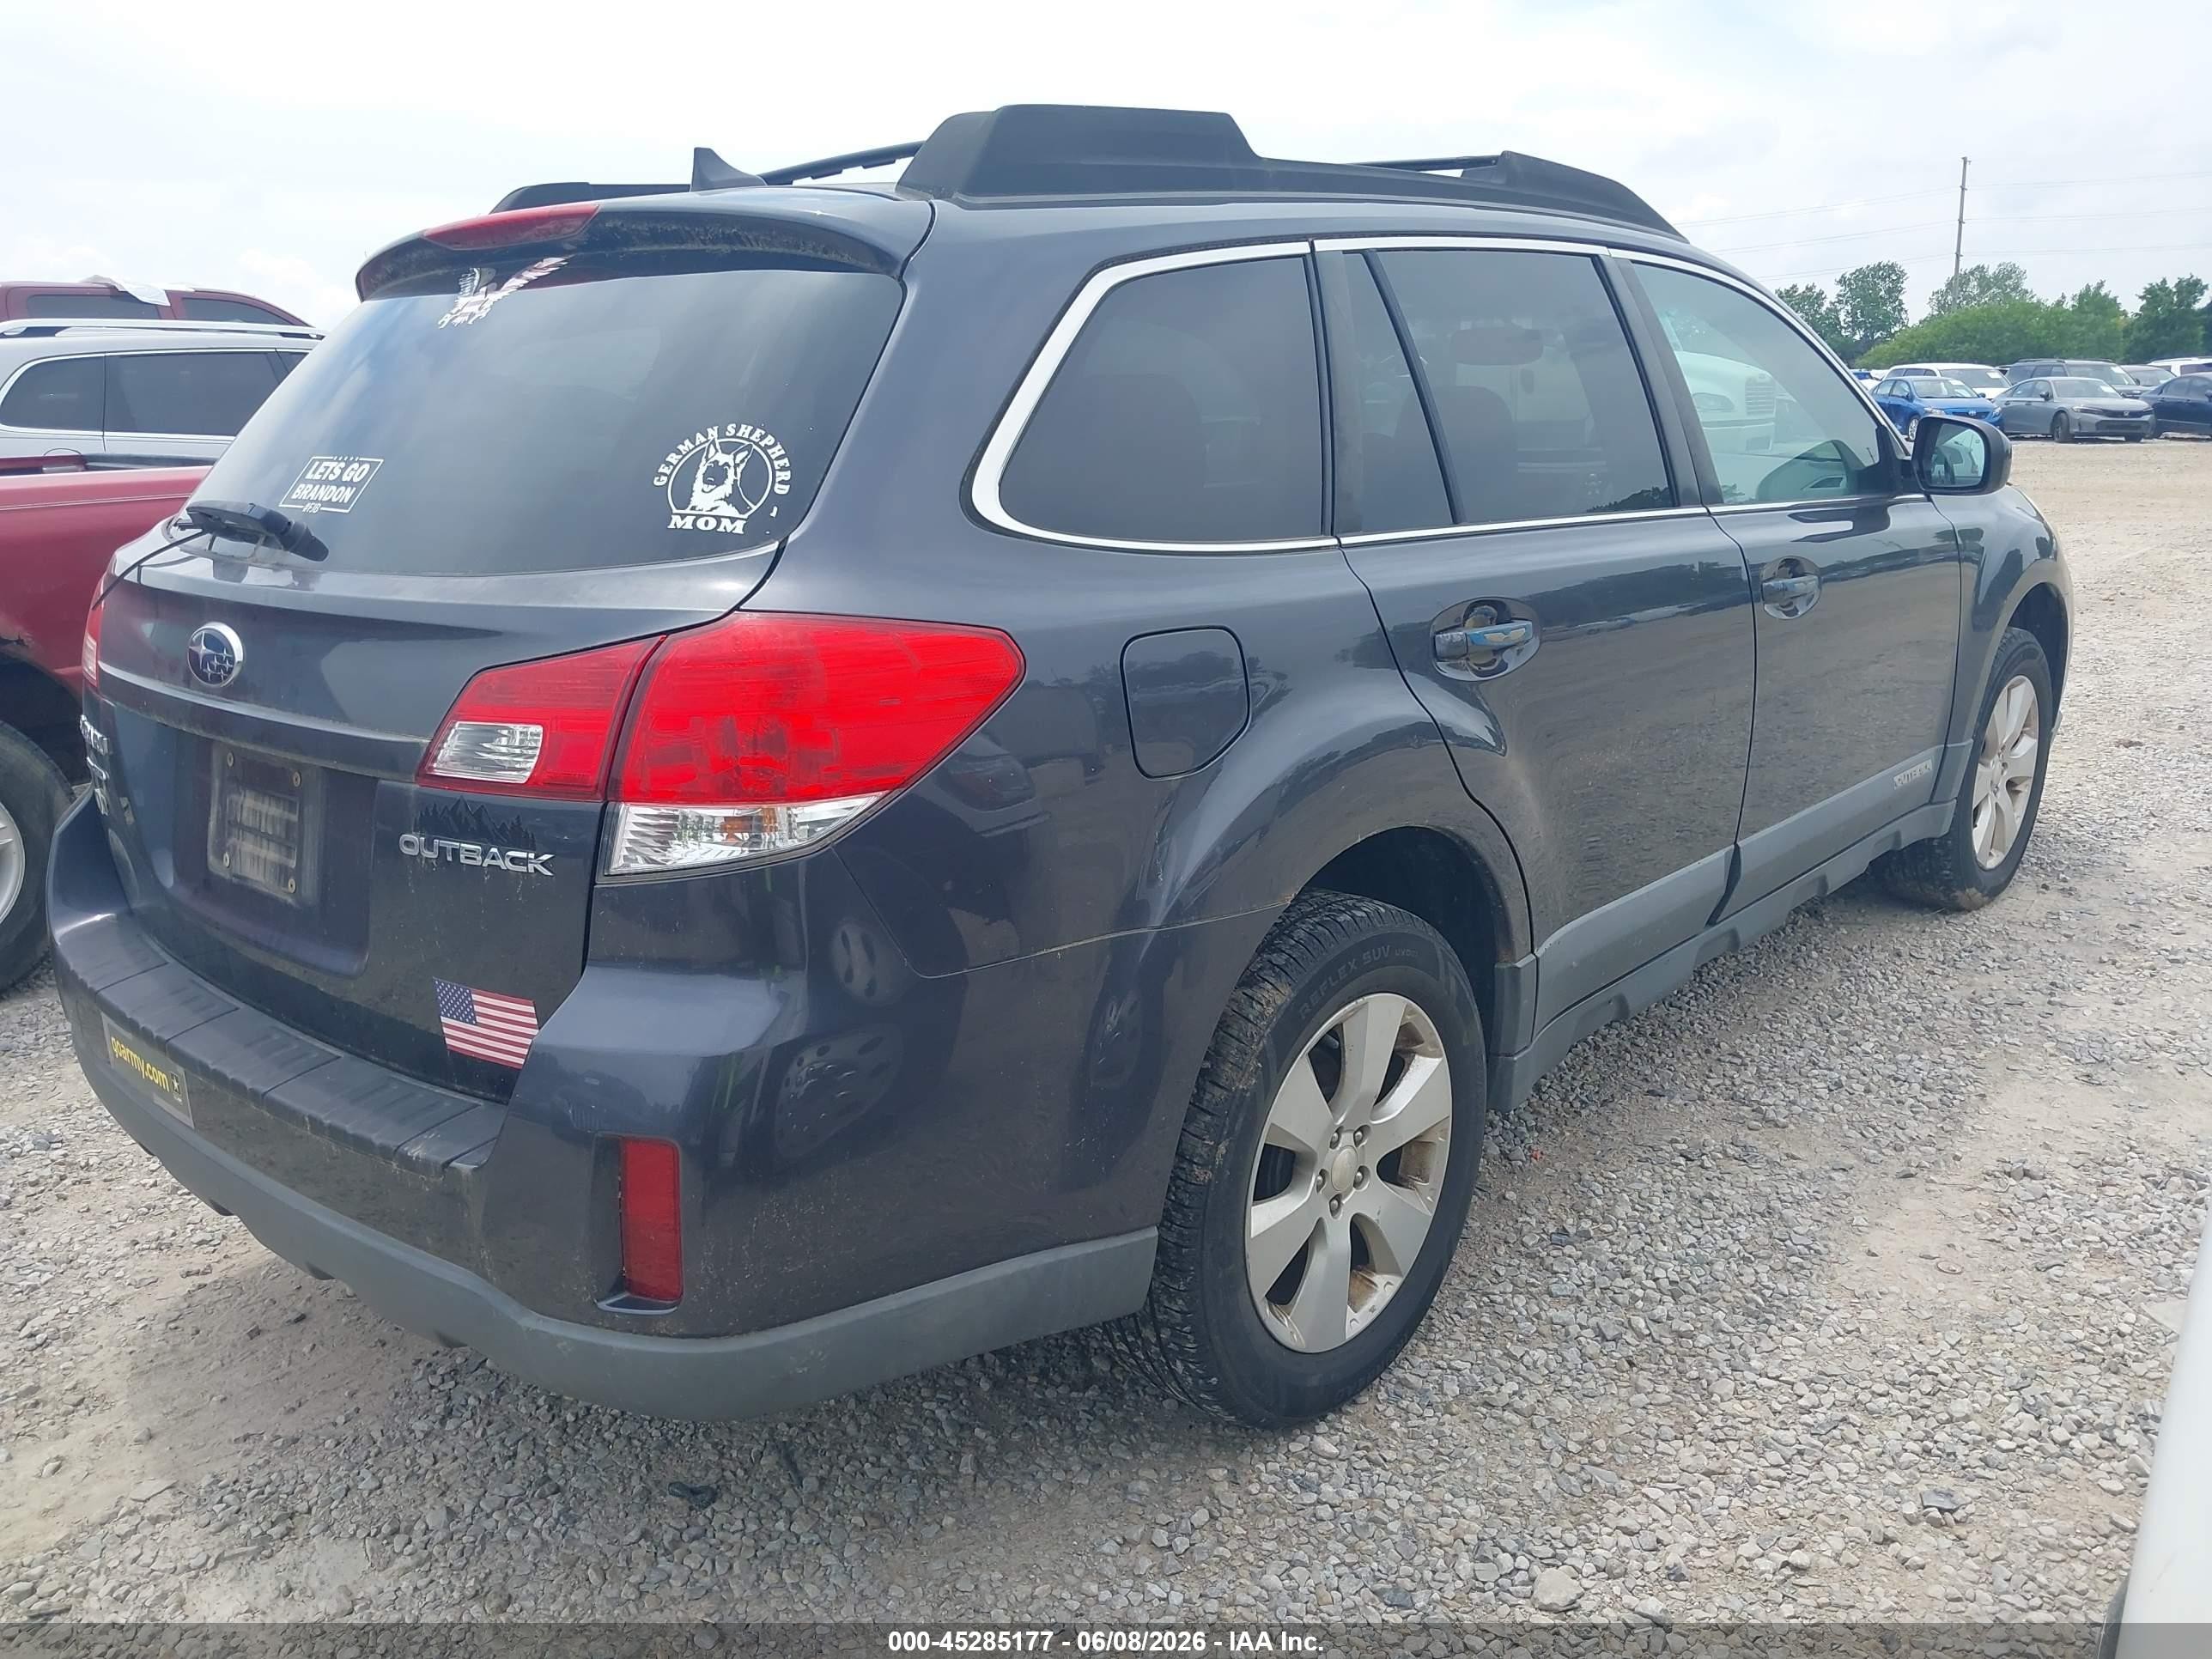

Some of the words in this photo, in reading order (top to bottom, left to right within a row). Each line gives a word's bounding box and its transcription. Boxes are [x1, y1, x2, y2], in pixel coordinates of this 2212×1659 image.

[305, 461, 345, 481] LETS
[342, 462, 370, 483] GO
[653, 426, 719, 486] GERMAN
[726, 423, 791, 495] SHEPHERD
[291, 483, 356, 503] BRANDON
[301, 502, 322, 514] #FJB
[667, 515, 746, 534] MOM
[398, 834, 555, 876] OUTBACK
[1299, 958, 1358, 1019] REFLEX
[1363, 945, 1391, 964] SUV
[112, 1036, 170, 1092] goarmy.com
